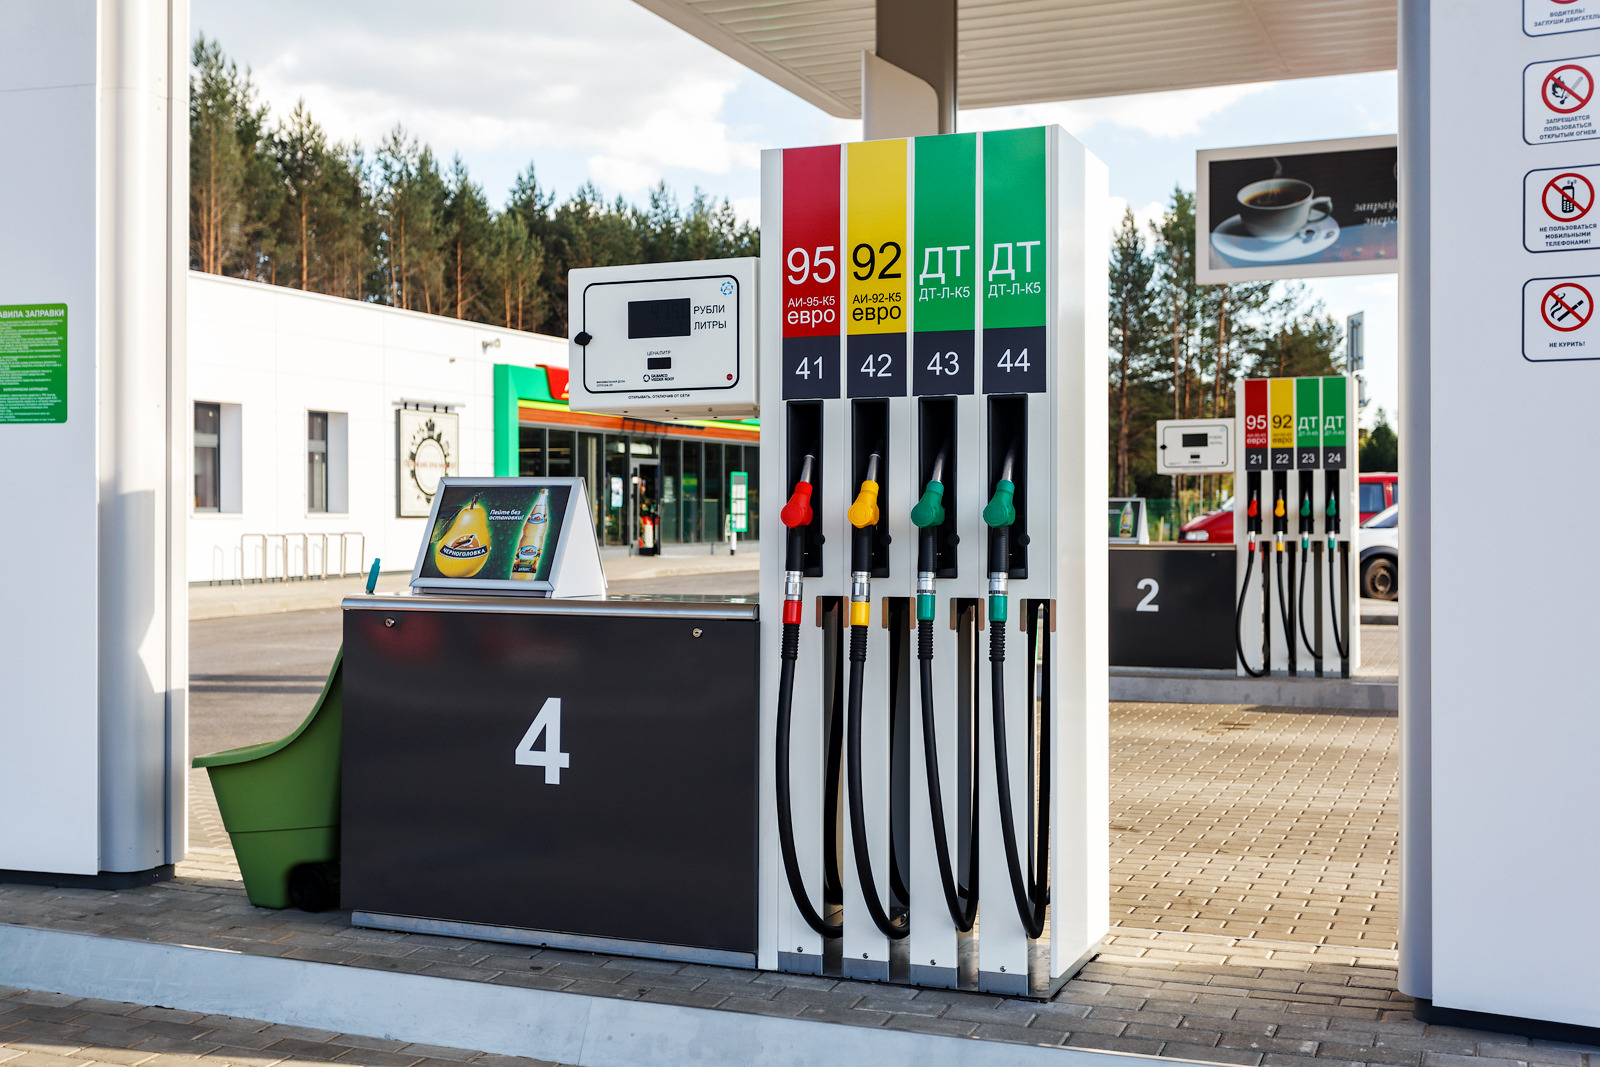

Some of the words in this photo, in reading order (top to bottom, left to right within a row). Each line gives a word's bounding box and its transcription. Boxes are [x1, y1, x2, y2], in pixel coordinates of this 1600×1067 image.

[1550, 8, 1585, 17] ВОДИТЕЛЬ!
[1565, 14, 1600, 24] ДВИГАТЕЛЬ
[1544, 122, 1592, 132] ПОЛЬЗОВАТЬСЯ
[1546, 115, 1590, 124] ЗАПРЕЩАЕТСЯ
[1549, 224, 1597, 232] ПОЛЬЗОВАТЬСЯ
[786, 245, 836, 285] 95
[852, 241, 902, 281] 92
[919, 245, 971, 286] ДТ
[988, 240, 1041, 282] ДТ
[918, 286, 971, 302] ДТ-Л-К5
[987, 281, 1042, 299] ДТ-Л-К5
[787, 295, 836, 308] АИ-95-К5
[852, 292, 902, 304] АИ-92-К5
[25, 309, 64, 318] ЗАПРАВКИ
[694, 304, 725, 314] РУБЛИ
[852, 305, 902, 325] евро
[694, 320, 727, 330] ЛИТРЫ
[787, 308, 836, 328] евро
[860, 353, 893, 378] 42
[926, 351, 960, 376] 43
[997, 347, 1031, 373] 44
[795, 356, 825, 380] 41
[1246, 415, 1267, 430] 95
[1272, 414, 1293, 430] 92
[1298, 416, 1318, 431] ДТ
[1324, 415, 1345, 431] ДТ
[1250, 454, 1262, 464] 21
[1276, 454, 1289, 464] 22
[1302, 453, 1316, 464] 23
[1328, 453, 1341, 464] 24
[443, 548, 486, 557] ЧЕРНОГОЛОВКА
[1135, 577, 1160, 613] 2
[514, 697, 570, 785] 4
